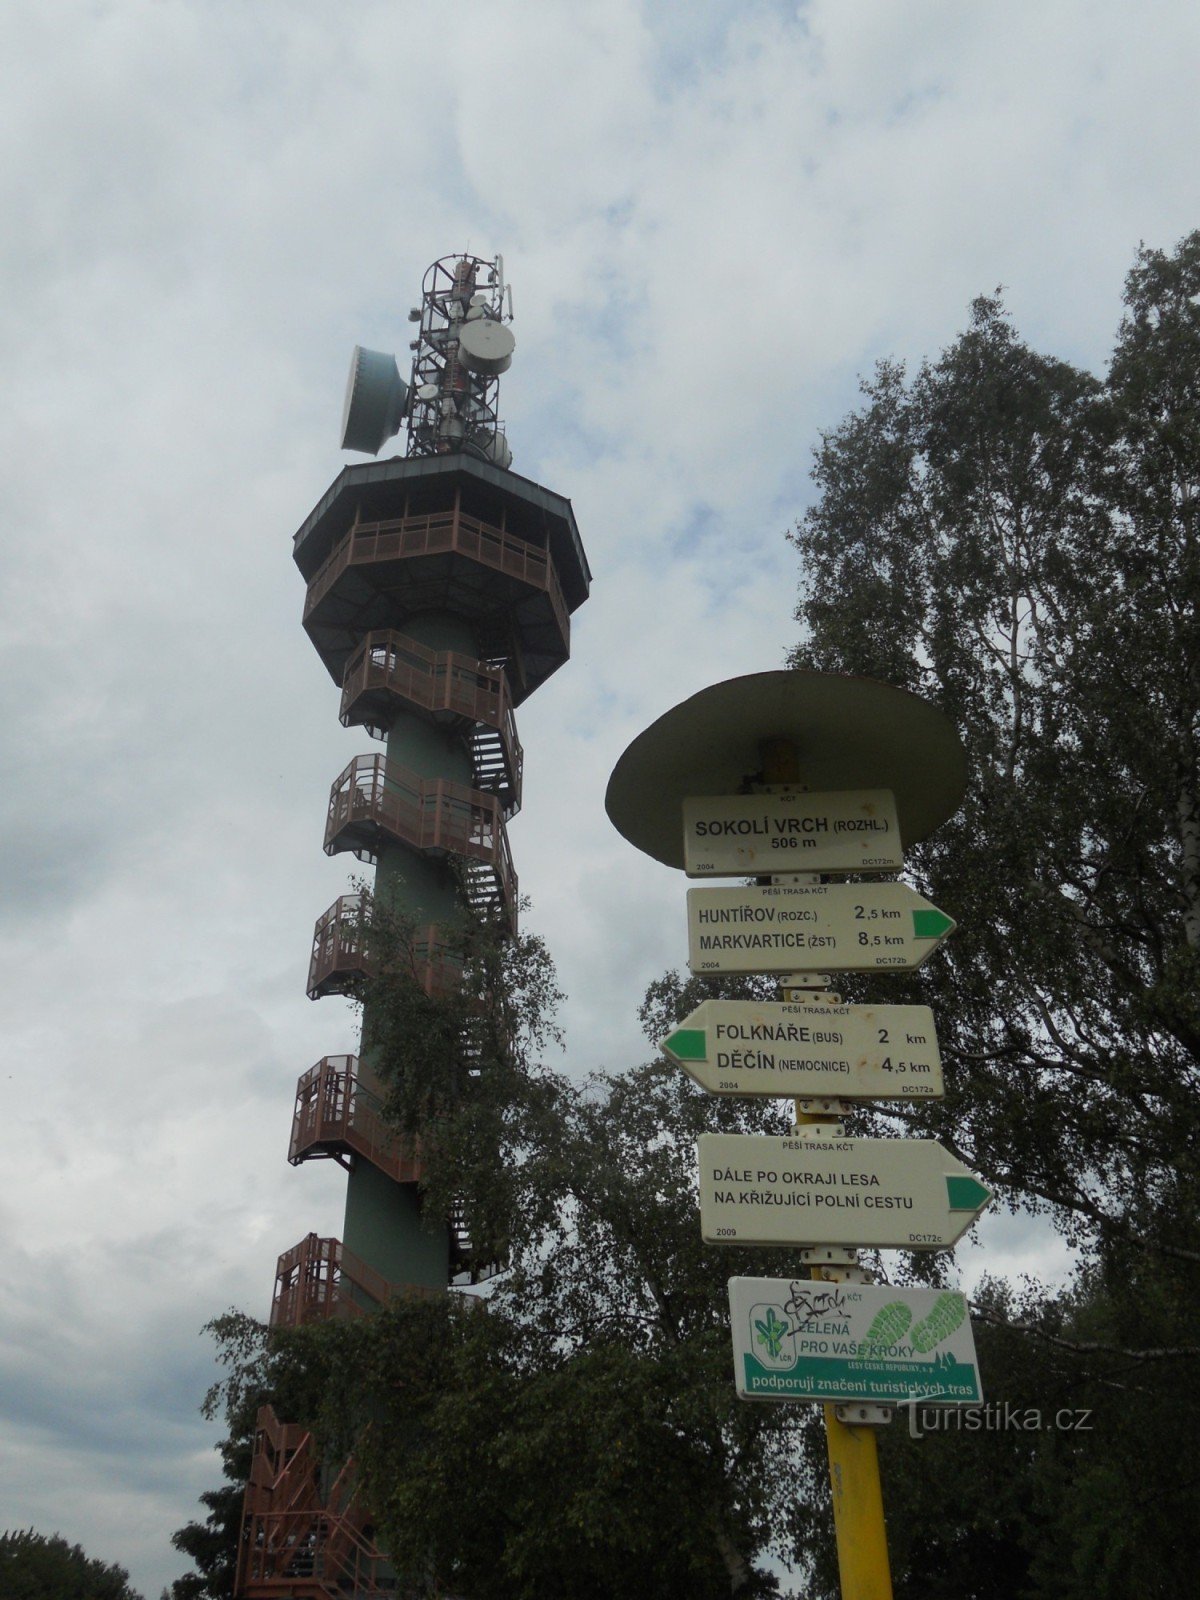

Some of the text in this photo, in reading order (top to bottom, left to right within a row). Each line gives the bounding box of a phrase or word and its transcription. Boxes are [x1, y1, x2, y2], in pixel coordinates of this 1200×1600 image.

[696, 816, 888, 836] SOKOLÍ VRCH (ROZHL.)
[772, 838, 816, 848] 506 m
[699, 905, 900, 923] HUNTÍŘOV (ROZC.) 2,5 km
[700, 932, 904, 949] MARKVARTICE (ŽST) 8,5 km
[833, 1007, 849, 1015] KČT
[716, 1023, 926, 1045] FOLKNÁŘE (BUS) 2 km
[718, 1050, 930, 1074] DĚČÍN (NEMOCNICE) 4,5 km
[836, 1142, 854, 1151] KČT
[713, 1167, 879, 1186] DÁLE PO OKRAJI LESA
[715, 1190, 913, 1209] NA KŘIŽUJÍCÍ POLNÍ CESTU
[909, 1234, 942, 1242] DC172c
[847, 1293, 862, 1301] KČT
[800, 1321, 849, 1335] ZELENÁ
[801, 1341, 916, 1358] PRO VAŠE KROKY
[753, 1375, 973, 1395] podporují značení turistických tras
